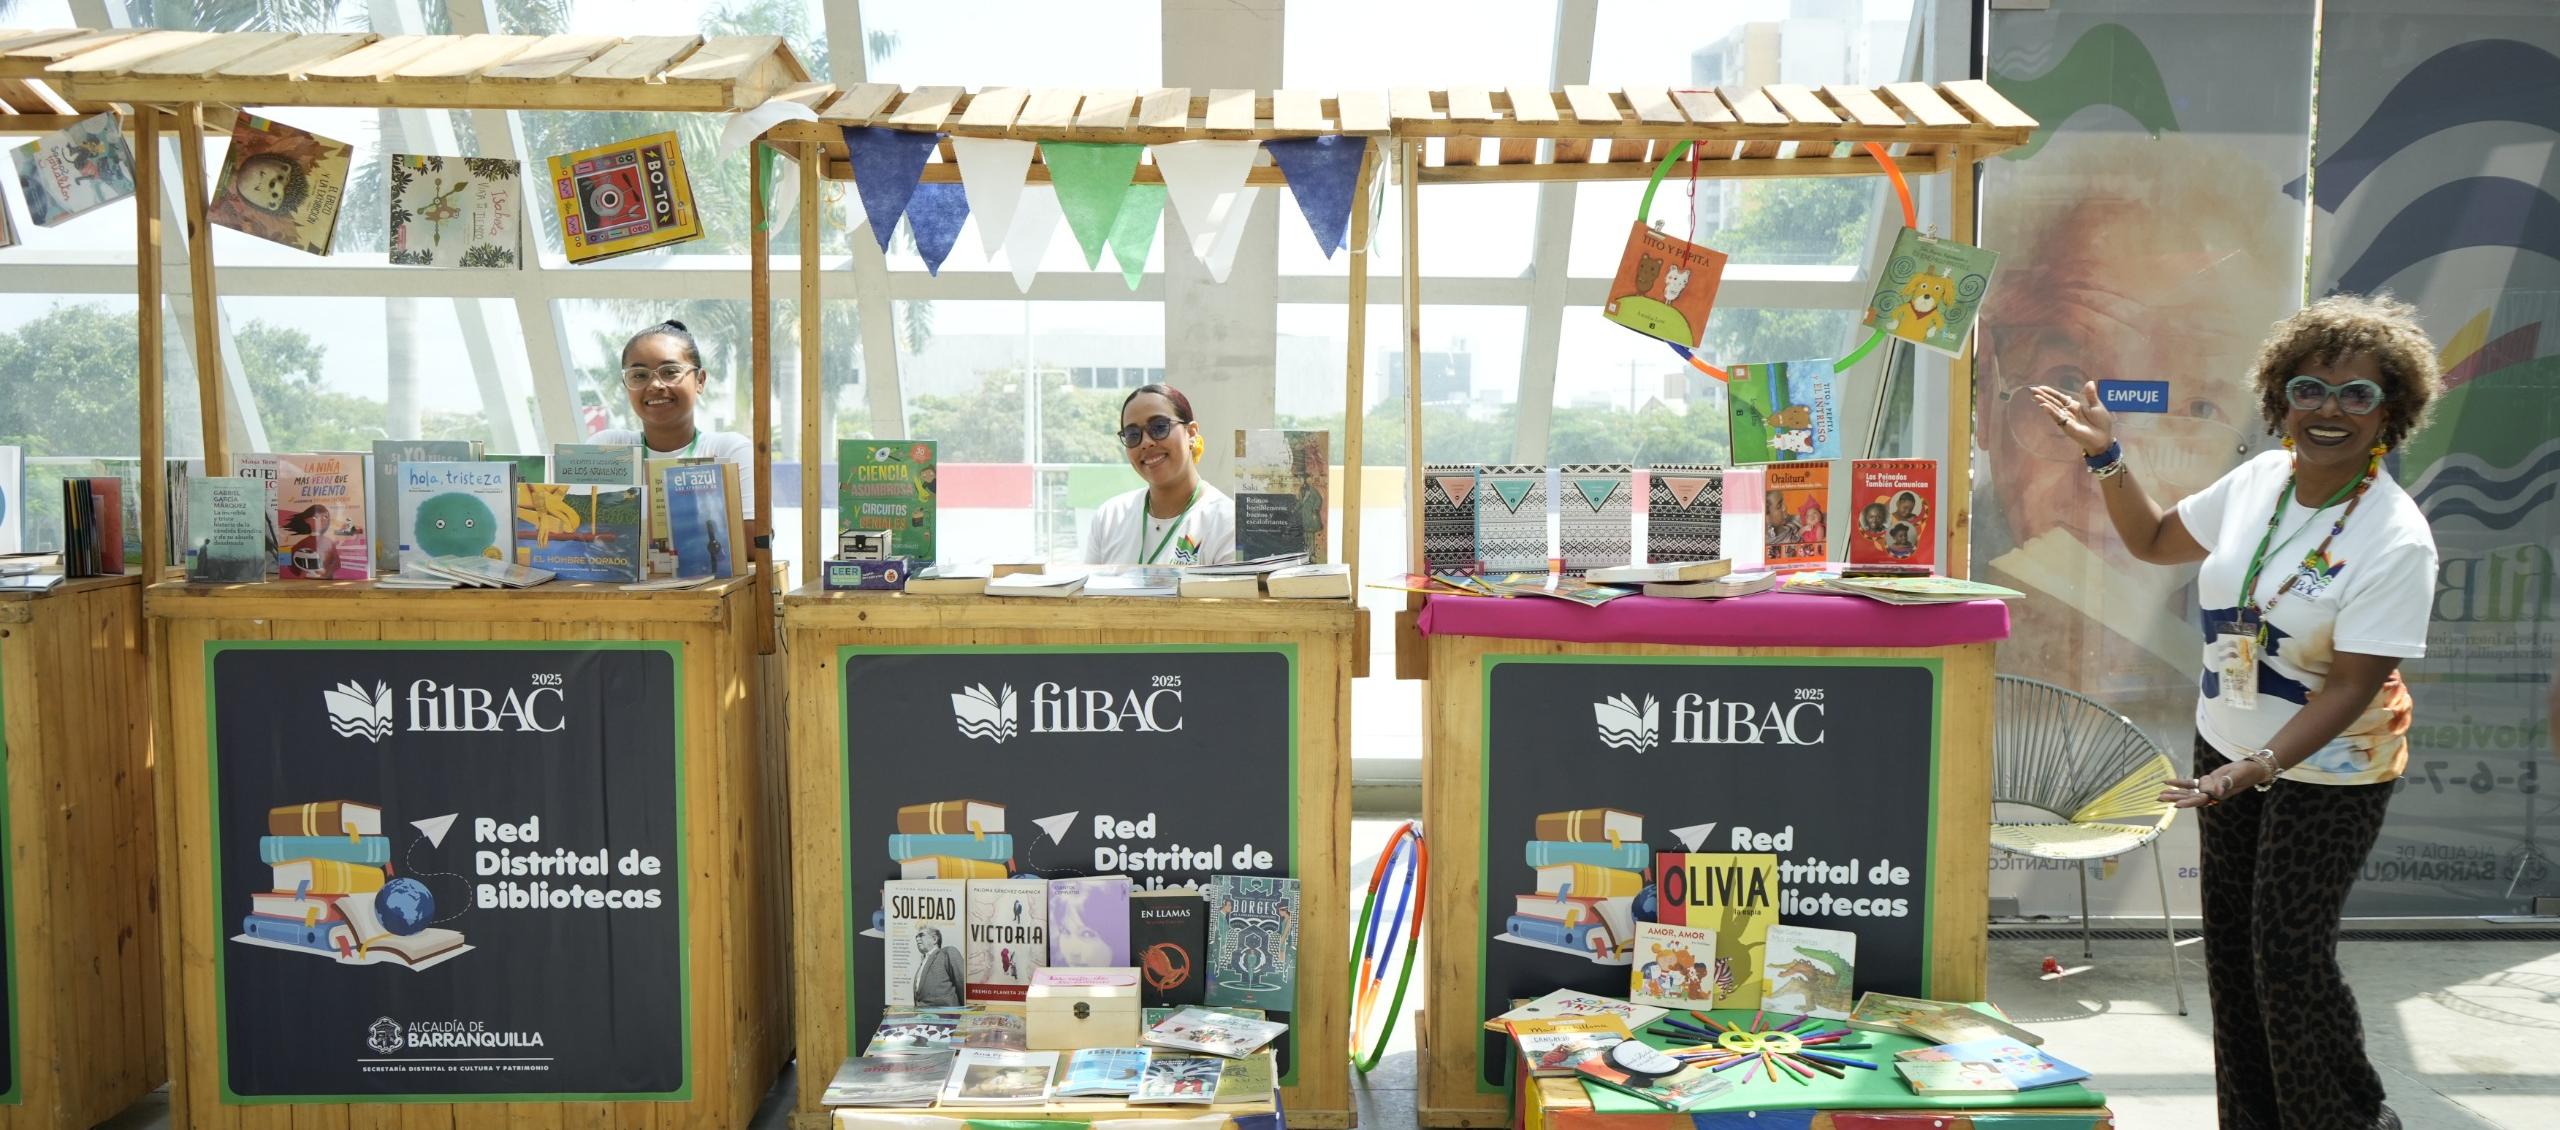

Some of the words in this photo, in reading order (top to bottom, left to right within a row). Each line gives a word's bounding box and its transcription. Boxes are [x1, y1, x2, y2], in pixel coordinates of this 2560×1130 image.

[648, 160, 669, 214] BO-TO
[1642, 235, 1665, 250] TITO
[1668, 245, 1675, 254] Y
[2107, 390, 2159, 404] EMPUJE
[316, 459, 340, 473] NIÑA
[858, 464, 909, 481] CIENCIA
[410, 468, 443, 487] hola,
[446, 470, 502, 485] tristeza
[674, 471, 686, 486] el
[690, 469, 717, 485] azul
[1772, 473, 1805, 484] Oralitura
[1866, 480, 1892, 488] También
[1894, 480, 1928, 488] Comunican
[1878, 472, 1907, 480] Peinados
[312, 485, 345, 497] VIENTO
[852, 483, 914, 497] ASOMBROSA
[862, 503, 907, 515] CIRCUITOS
[548, 557, 586, 565] HOMBRE
[588, 557, 627, 566] DORADO
[832, 567, 858, 576] LEER
[531, 673, 563, 686] 2025
[1152, 675, 1182, 687] 2025
[1794, 688, 1824, 700] 2025
[406, 679, 565, 732] filBAC
[1030, 681, 1183, 733] filBAC
[1671, 693, 1825, 746] filBAC
[474, 816, 539, 843] Red
[1094, 813, 1156, 839] Red
[1731, 825, 1794, 851] Red
[476, 848, 609, 876] Distrital
[618, 849, 662, 876] de
[1095, 844, 1222, 871] Distrital
[1232, 844, 1273, 870] de
[1777, 857, 1859, 885] trital
[1868, 859, 1910, 886] de
[1664, 866, 1770, 907] OLIVIA
[476, 882, 662, 910] Bibliotecas
[1779, 888, 1908, 918] liotecas
[892, 895, 956, 921] SOLEDAD
[1141, 910, 1154, 918] EN
[1156, 909, 1191, 918] LLAMAS
[1233, 900, 1277, 915] BORGES
[1734, 908, 1743, 916] la
[971, 924, 1043, 944] VICTORIA
[1648, 927, 1677, 938] AMOR,
[1678, 930, 1705, 940] AMOR
[408, 1019, 465, 1032] ALCALDÍA
[470, 1021, 484, 1032] DE
[408, 1032, 544, 1048] BARRANQUILLA
